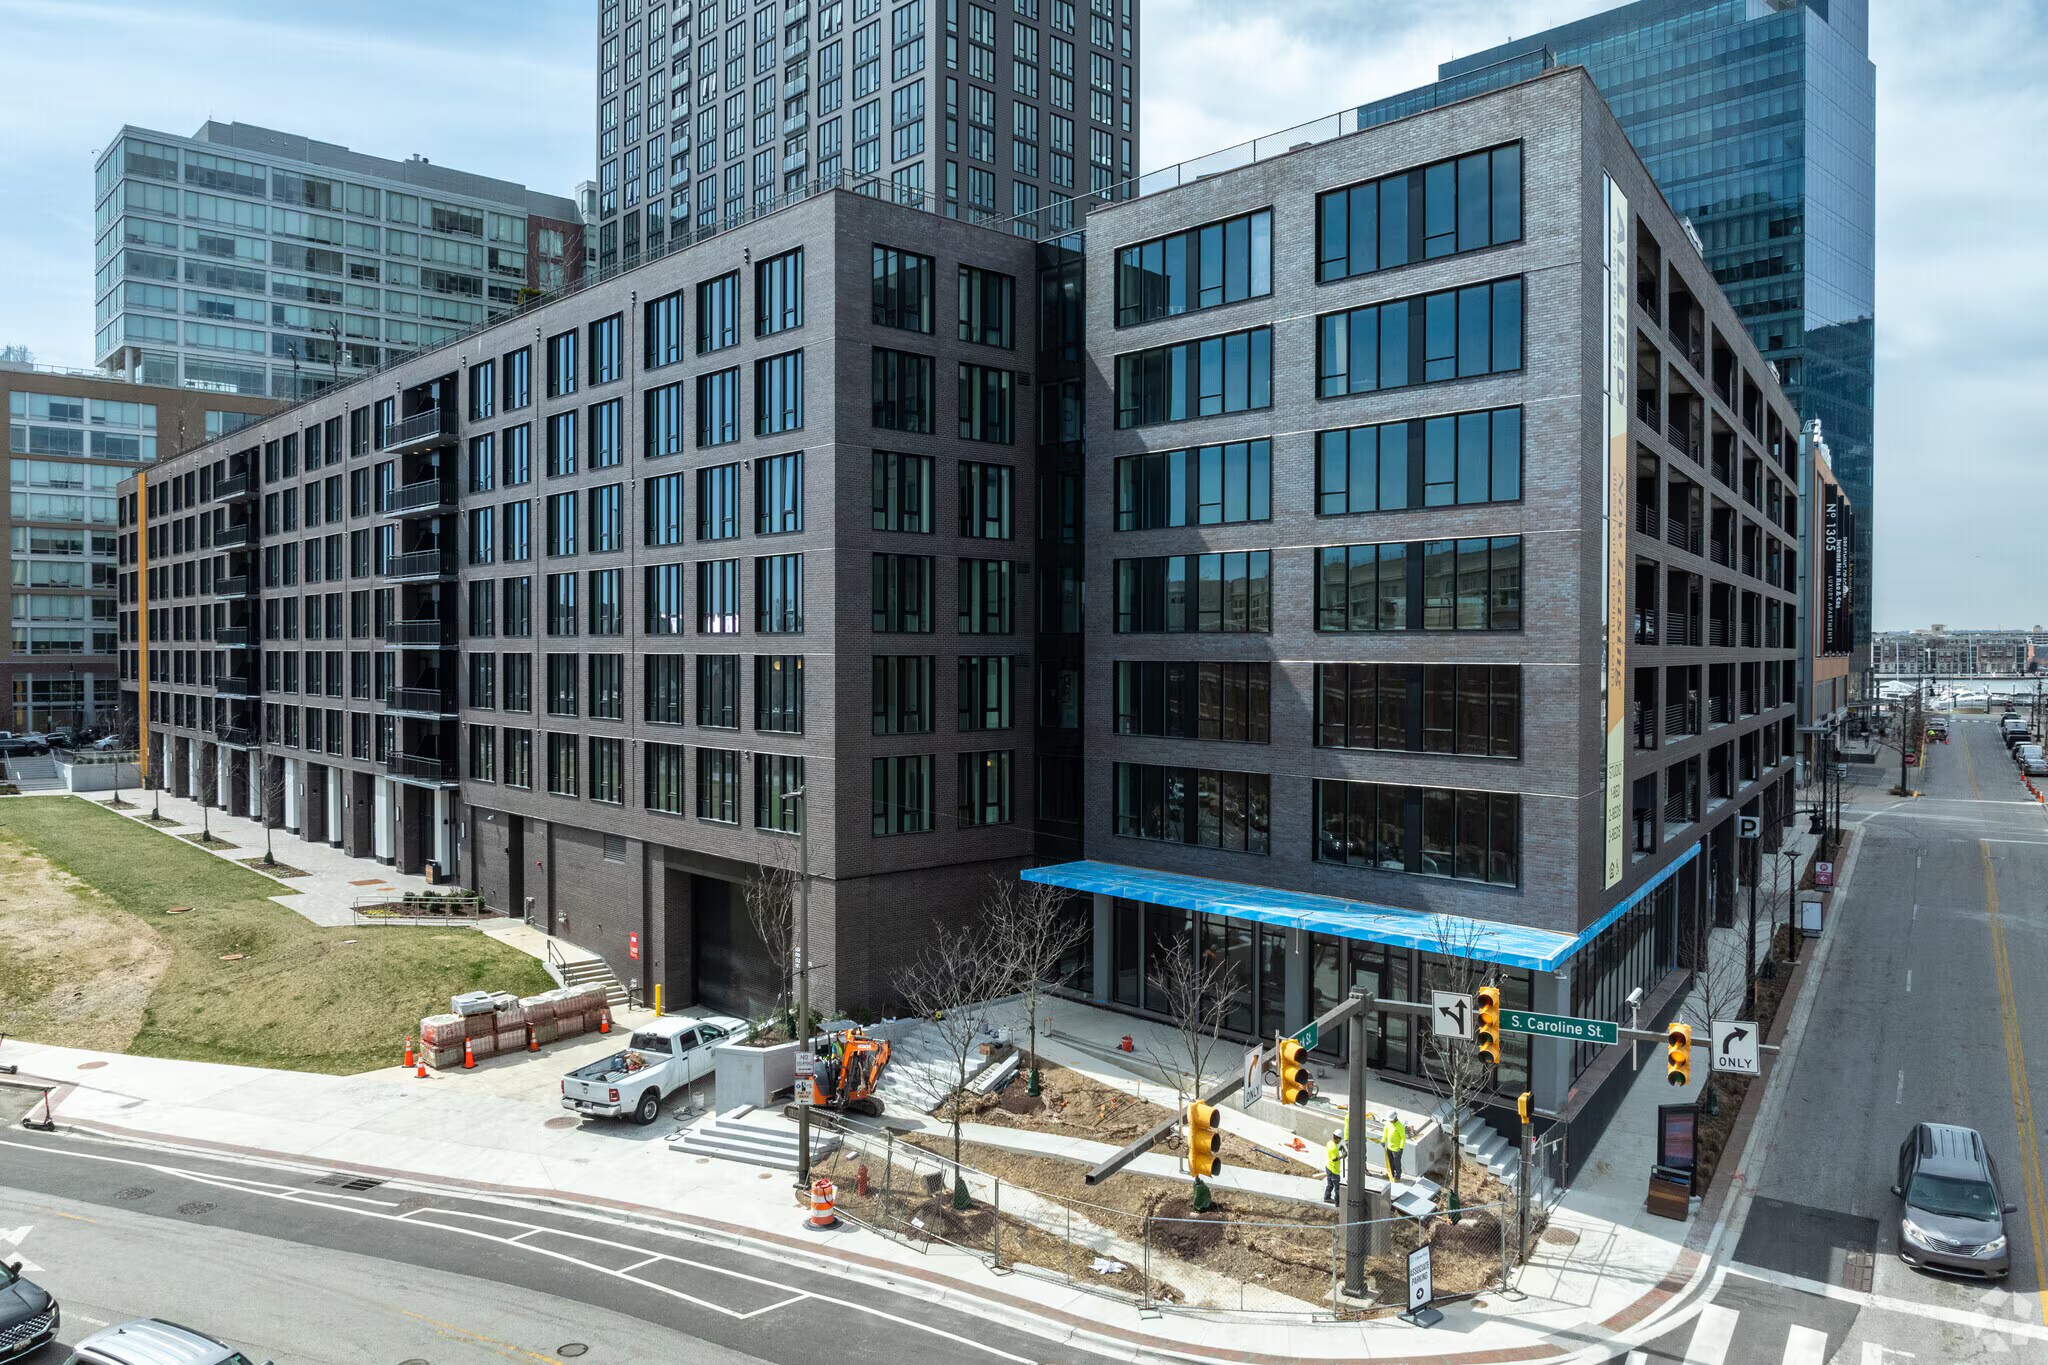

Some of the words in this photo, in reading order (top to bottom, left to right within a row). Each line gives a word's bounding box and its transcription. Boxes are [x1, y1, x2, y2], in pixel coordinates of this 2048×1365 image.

[1617, 207, 1625, 406] ALLIED
[1825, 523, 1837, 552] 1305
[1826, 602, 1834, 644] APARTMENTS
[1609, 763, 1622, 779] STUDIO
[1741, 819, 1757, 836] P
[1511, 1015, 1523, 1028] S.
[1527, 1017, 1583, 1035] Caroline
[1587, 1024, 1604, 1038] St.
[1719, 1057, 1752, 1069] ONLY
[1246, 1084, 1260, 1103] ONLY
[1412, 1271, 1428, 1287] PARKING
